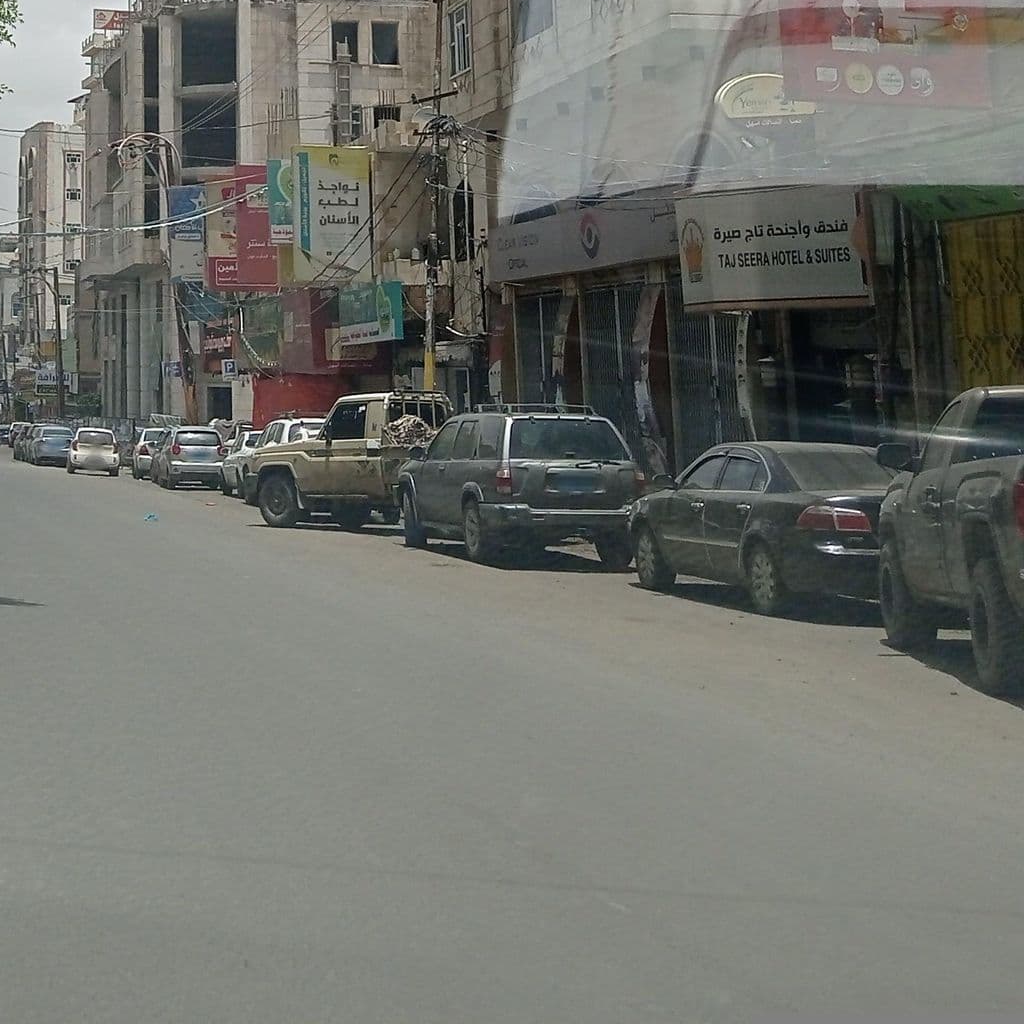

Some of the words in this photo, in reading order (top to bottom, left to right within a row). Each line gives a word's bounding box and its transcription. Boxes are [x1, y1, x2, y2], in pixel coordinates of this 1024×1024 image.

[317, 180, 359, 194] نواجذ
[318, 197, 358, 209] لطب
[319, 211, 359, 226] الأسنان
[745, 225, 763, 242] تاج
[767, 220, 811, 239] واجنحة
[814, 219, 849, 234] فندق
[714, 227, 741, 243] صيرة
[718, 253, 736, 268] TAJ
[738, 251, 770, 267] SEERA
[771, 250, 802, 266] HOTEL
[806, 249, 813, 263] &
[815, 247, 850, 263] SUITES
[226, 362, 234, 372] P
